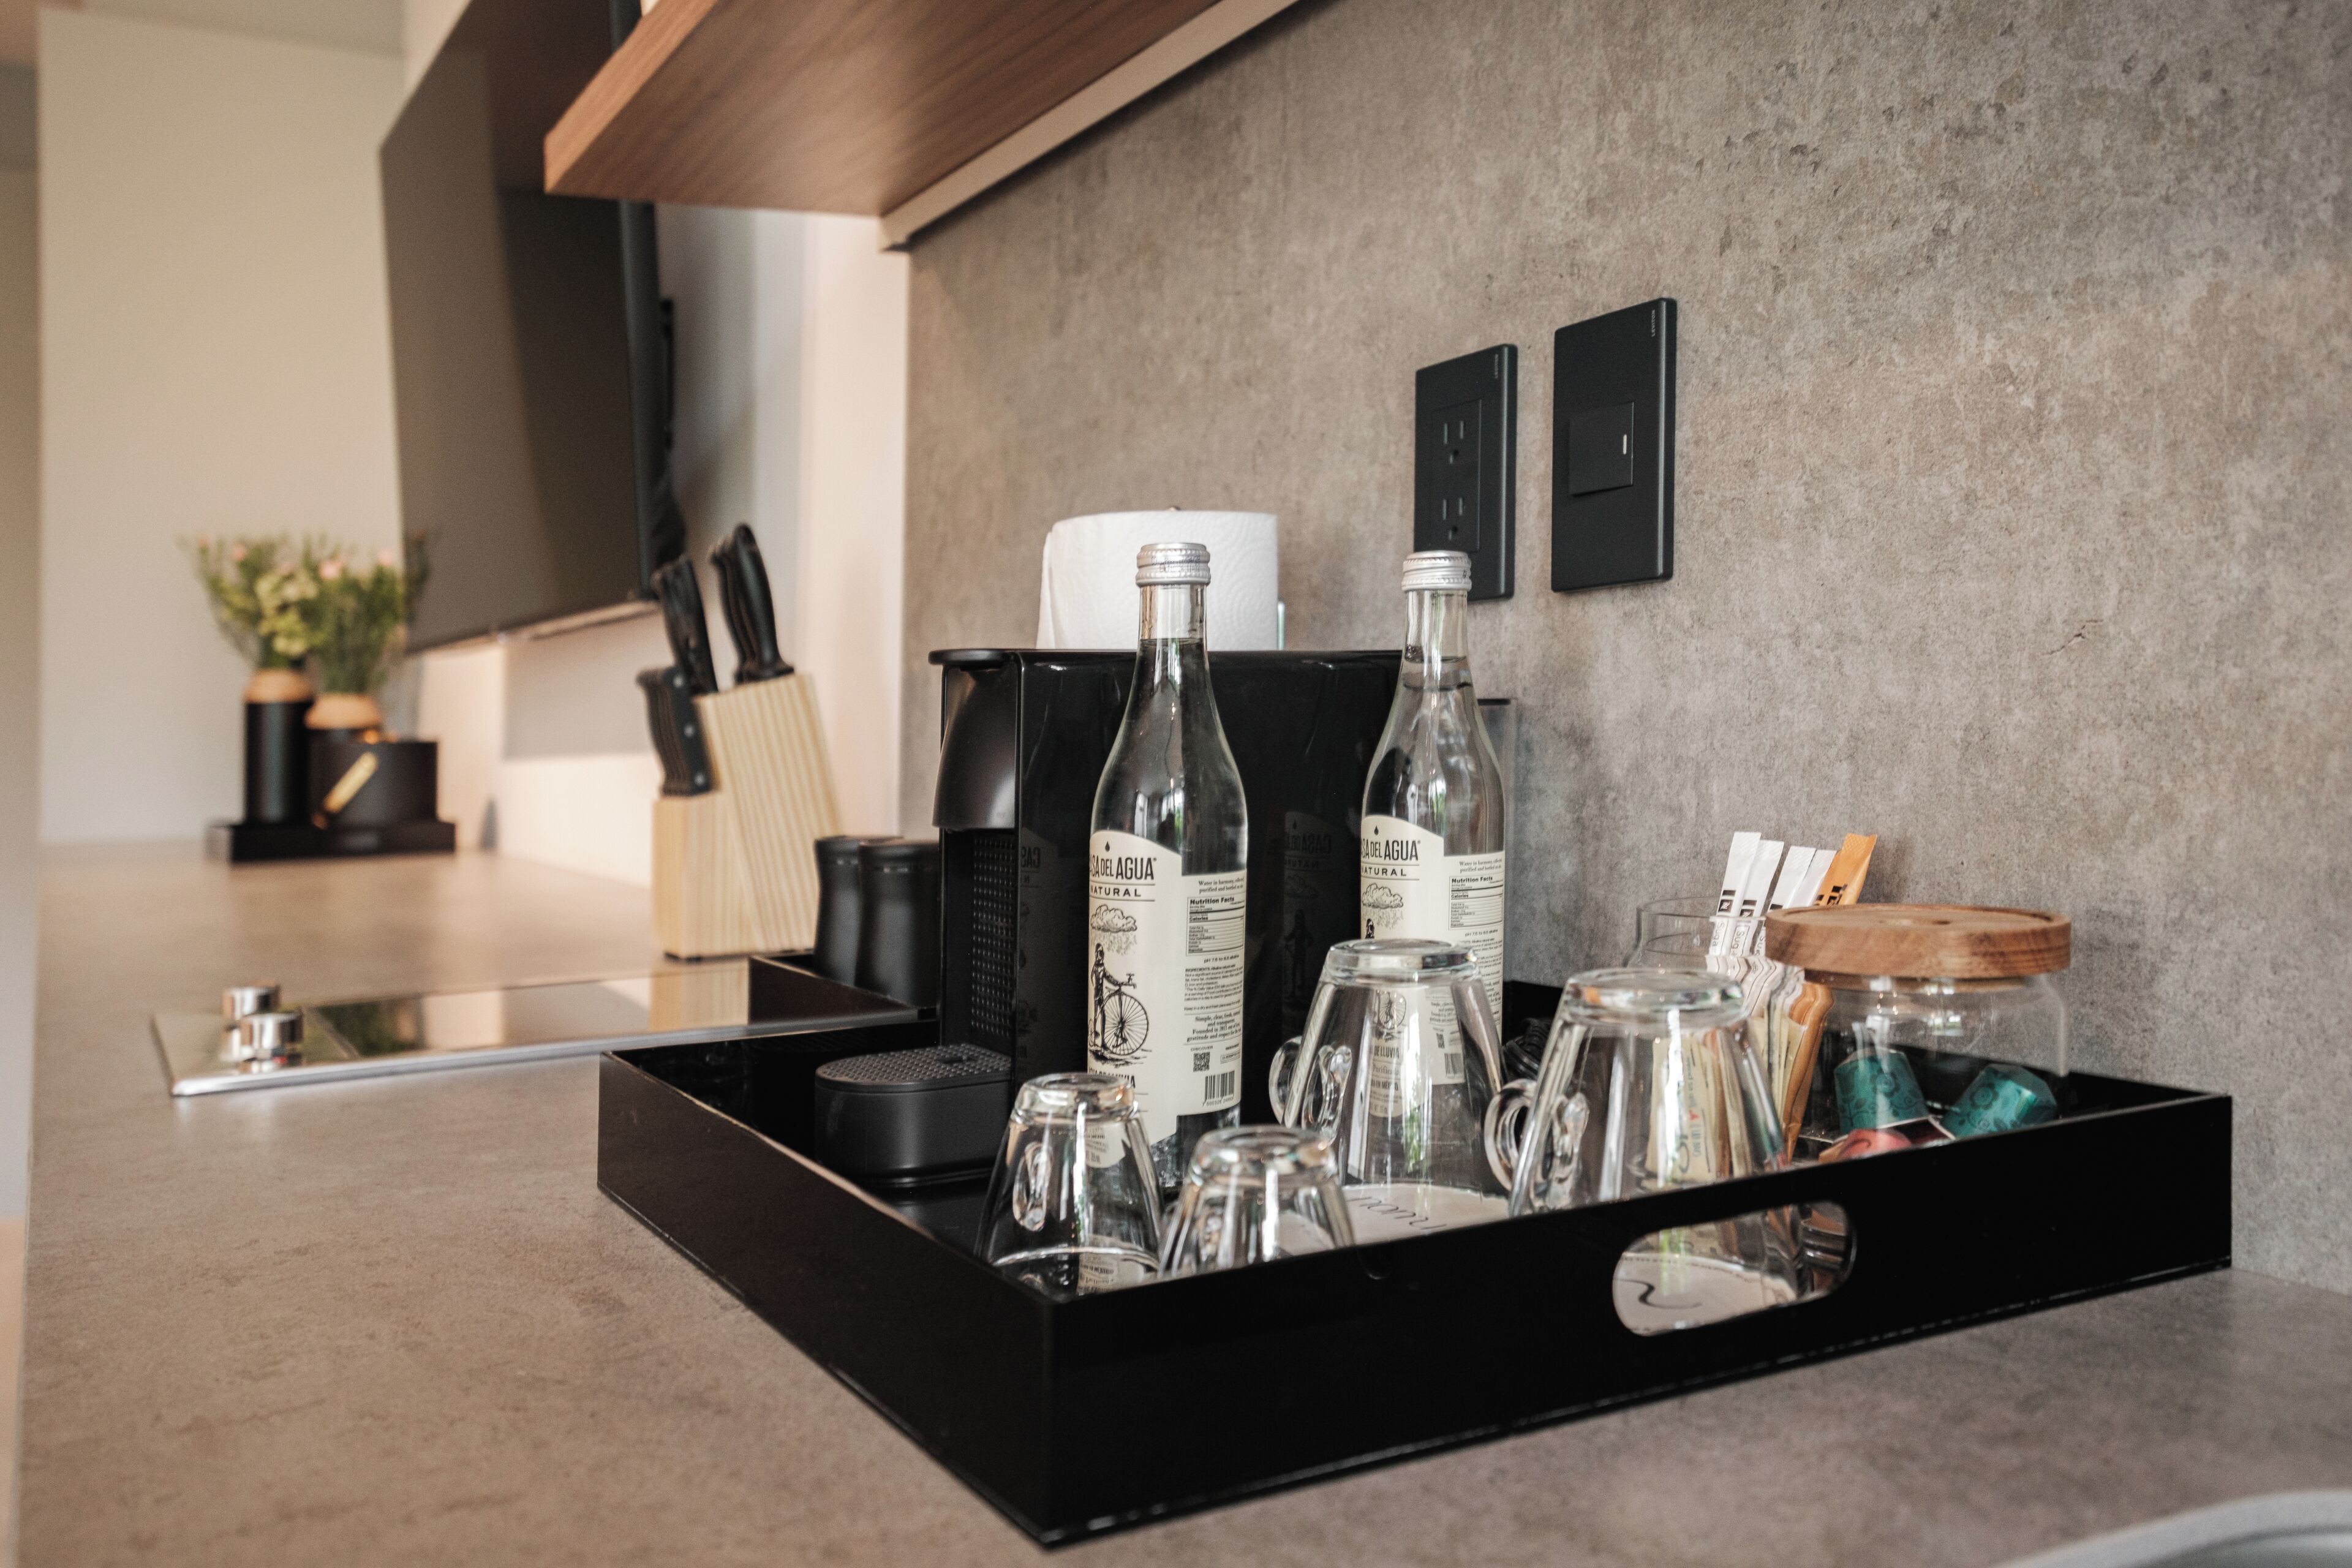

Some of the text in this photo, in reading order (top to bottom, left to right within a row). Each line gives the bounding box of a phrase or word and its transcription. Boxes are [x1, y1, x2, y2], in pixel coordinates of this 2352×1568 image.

[1370, 841, 1382, 858] DEL
[1384, 840, 1419, 861] AGUA
[1101, 858, 1114, 876] DEL
[1115, 857, 1155, 880] AGUA
[1199, 886, 1218, 894] purified
